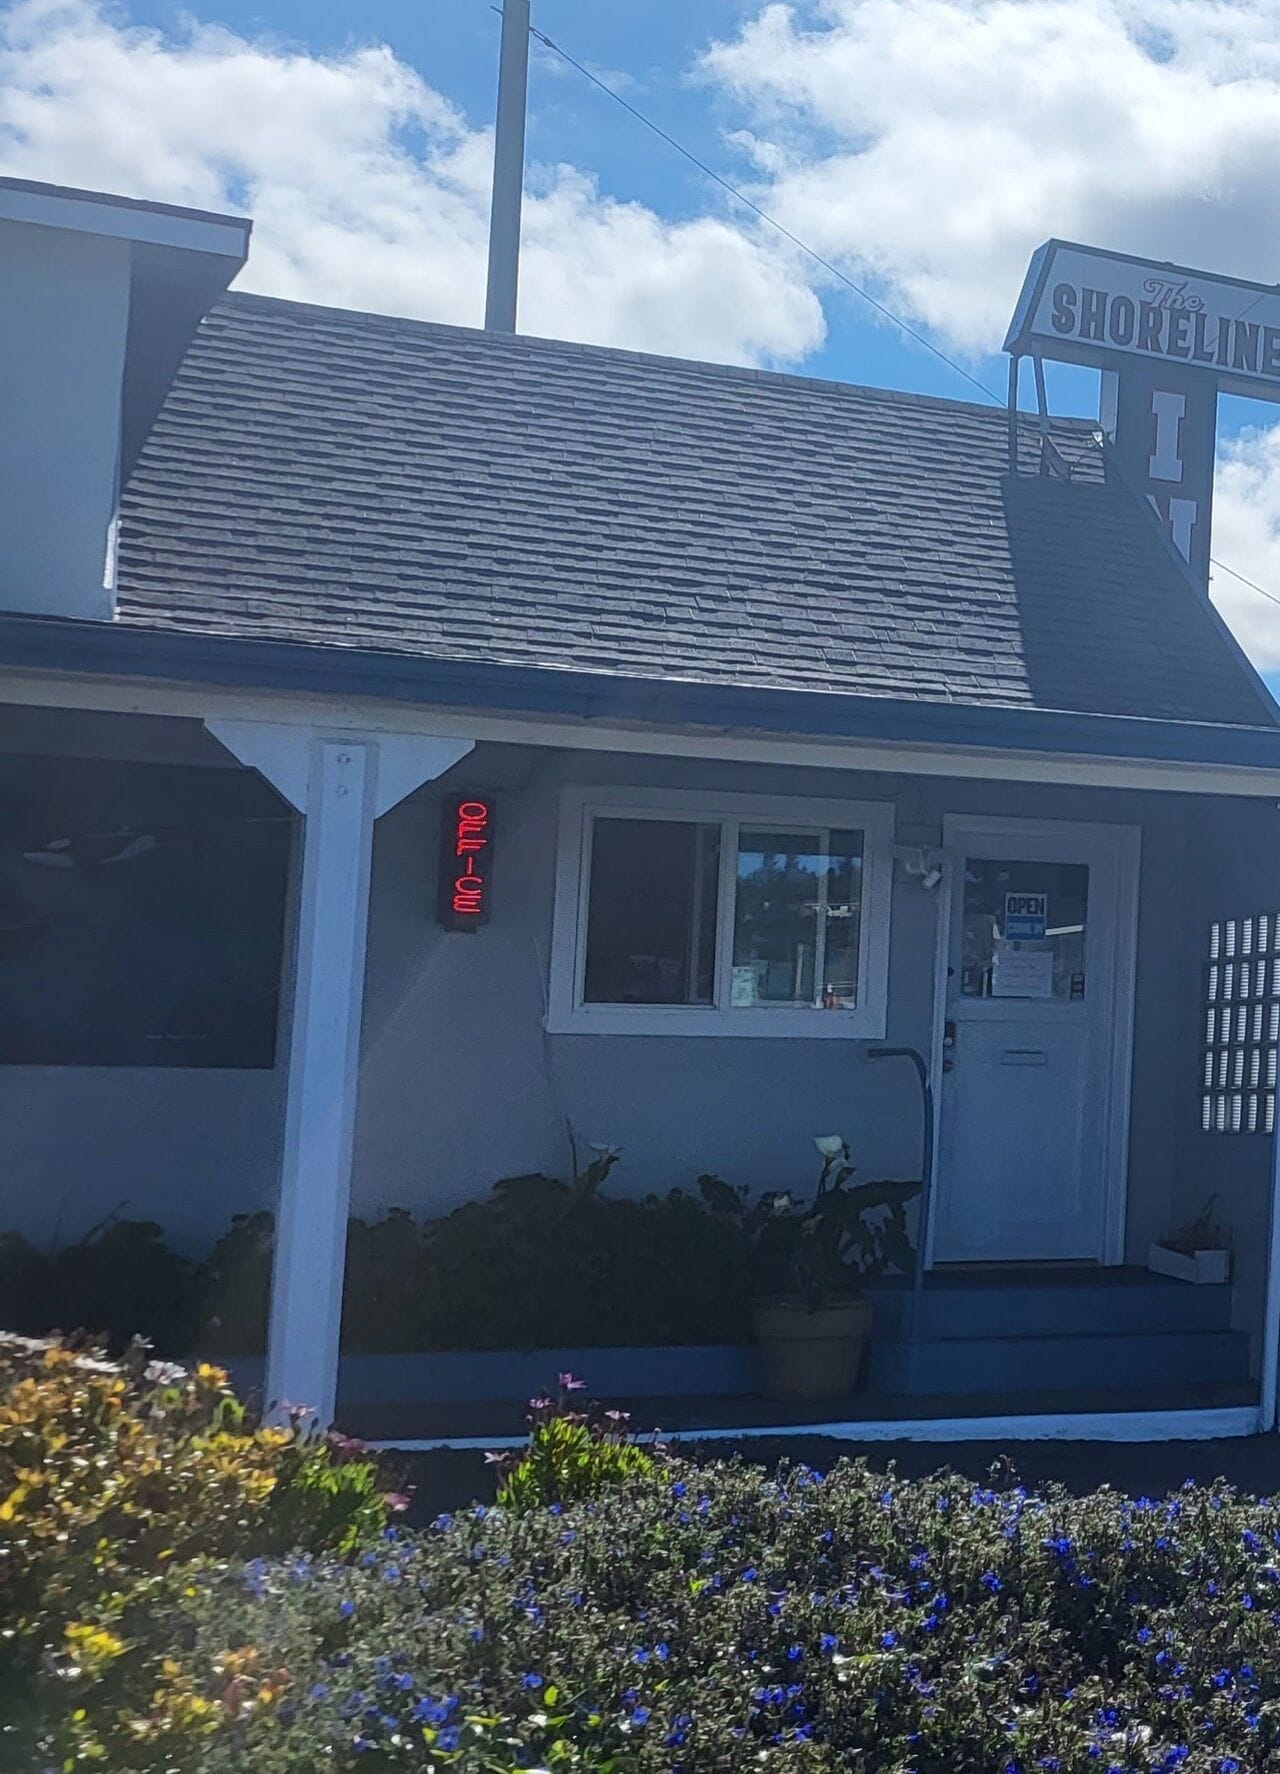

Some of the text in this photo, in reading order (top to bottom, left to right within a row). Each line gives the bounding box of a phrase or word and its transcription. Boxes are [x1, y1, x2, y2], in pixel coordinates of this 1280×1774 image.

[1143, 278, 1204, 312] The
[453, 802, 488, 914] OFFICE
[1007, 896, 1045, 914] OPEN
